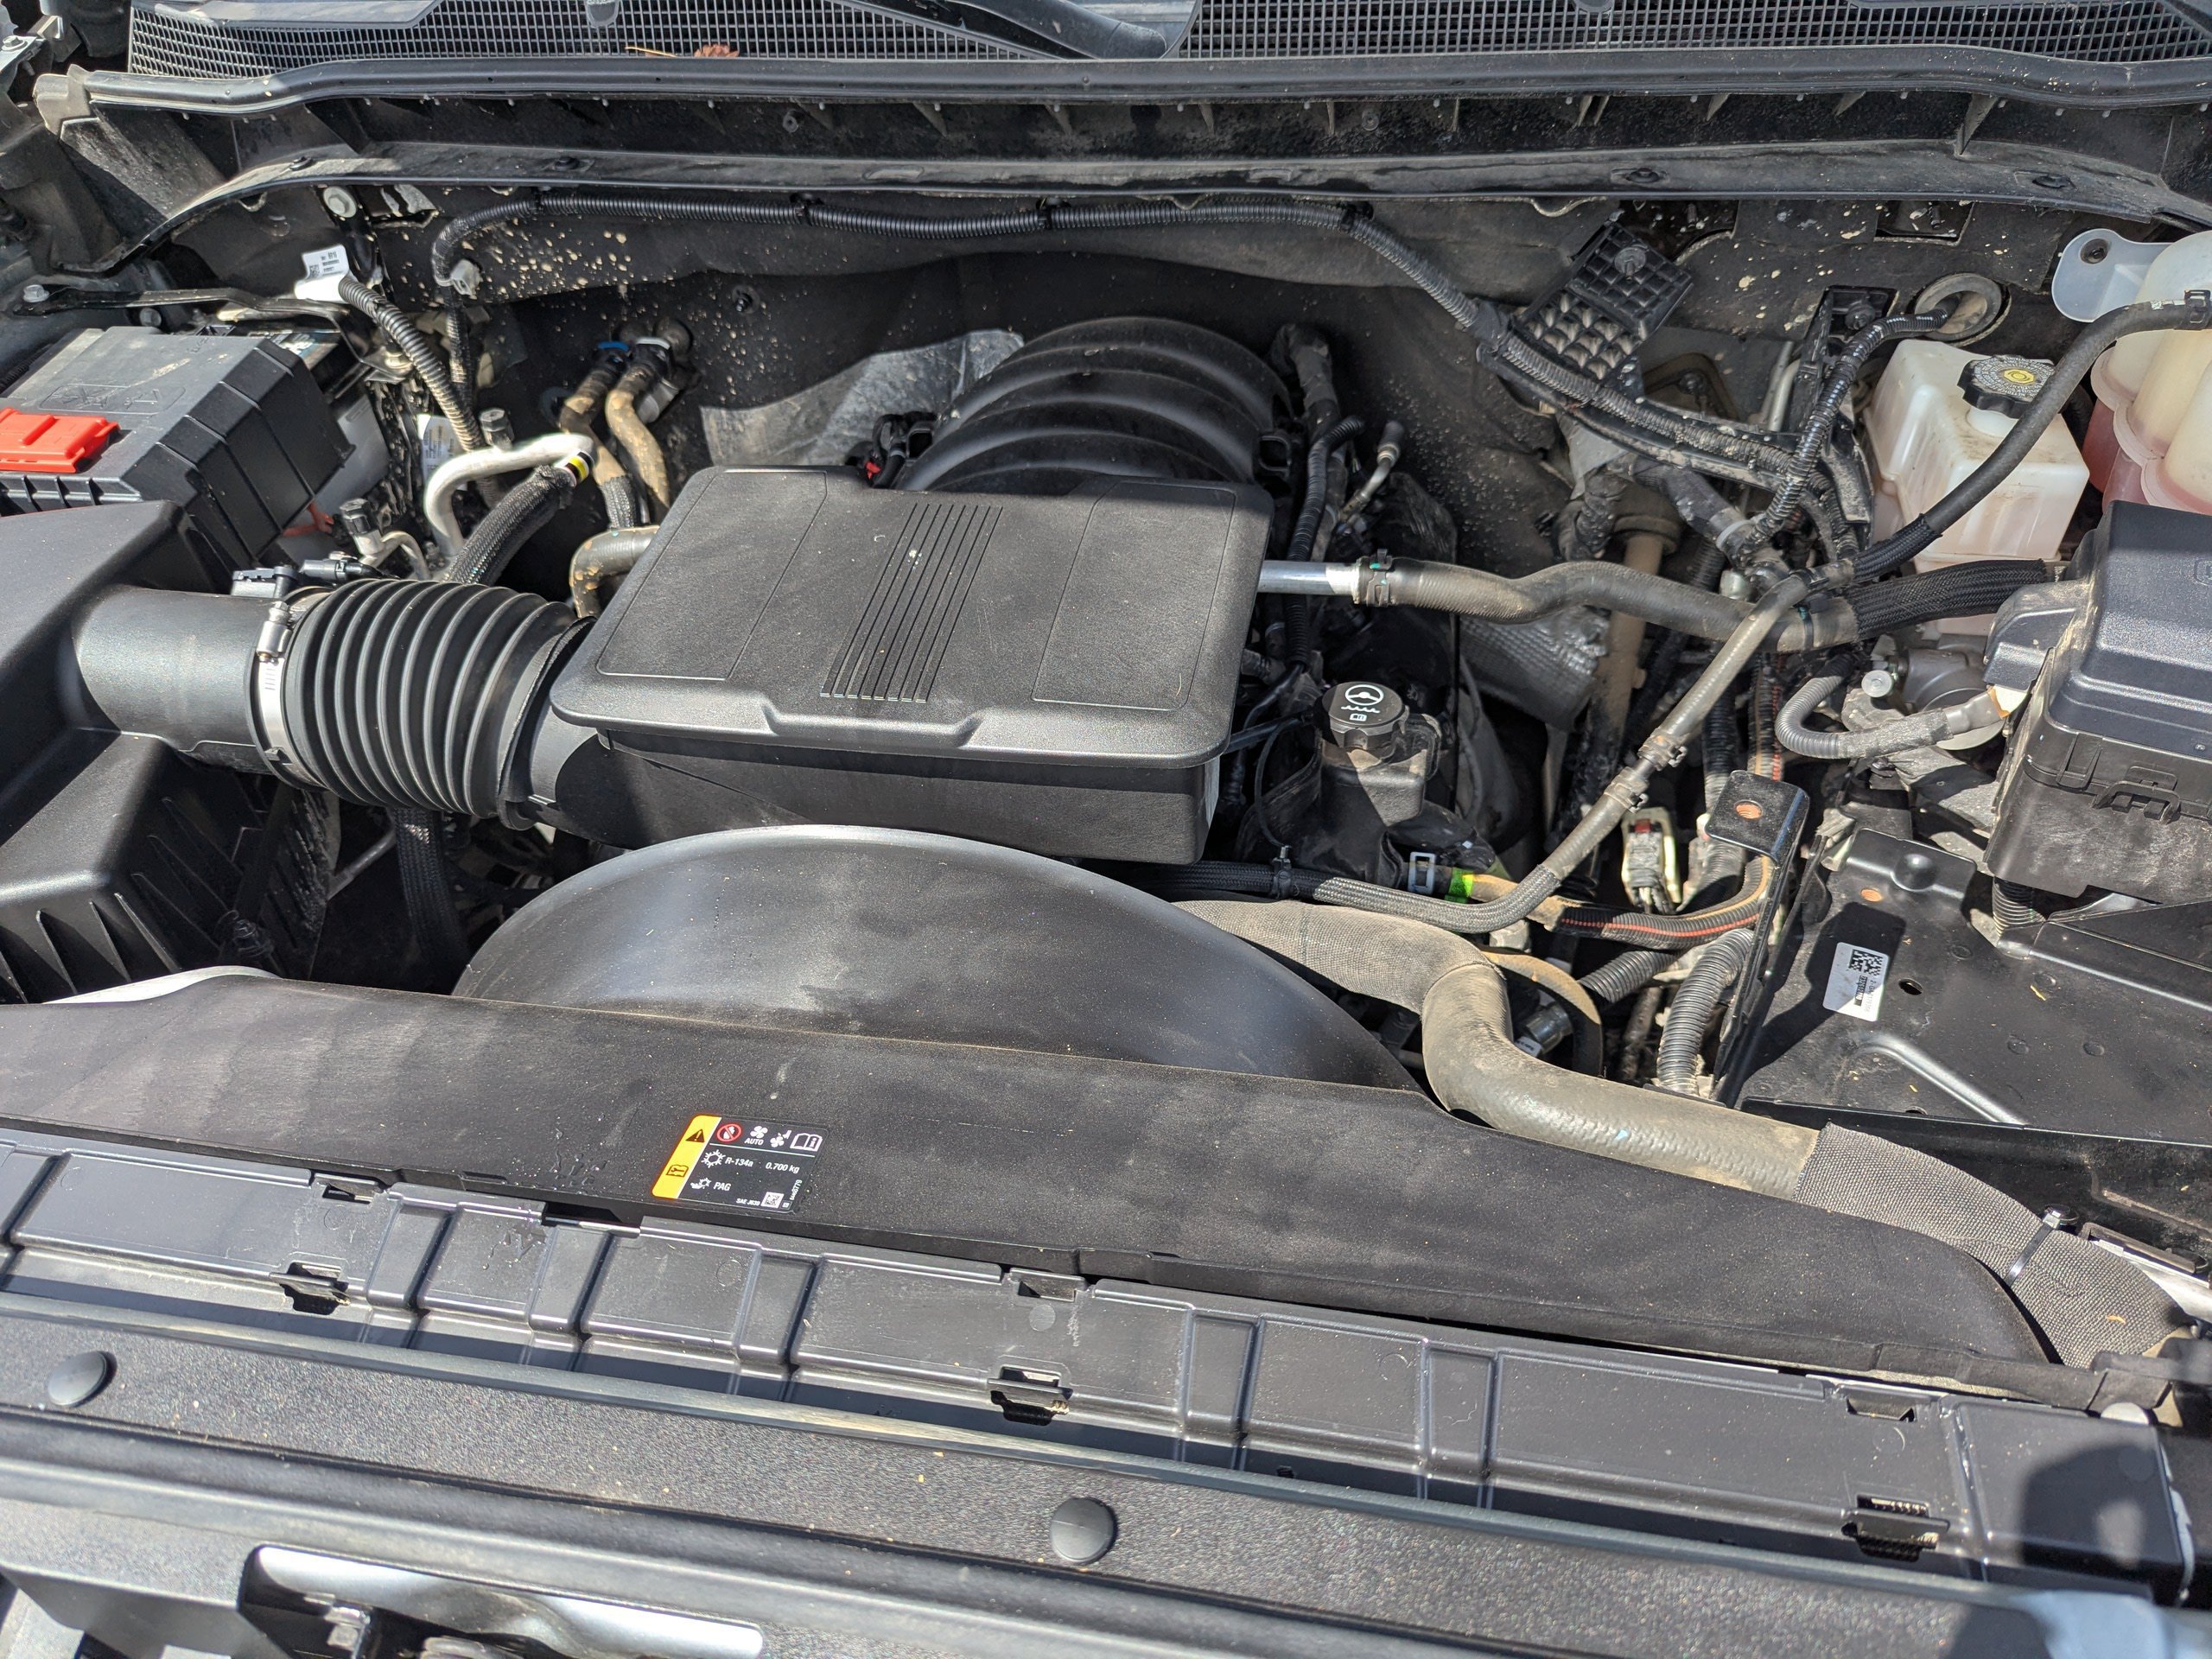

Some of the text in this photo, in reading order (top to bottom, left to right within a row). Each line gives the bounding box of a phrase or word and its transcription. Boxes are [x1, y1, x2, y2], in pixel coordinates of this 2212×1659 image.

[725, 1157, 754, 1167] R-134a
[766, 1161, 800, 1174] 0.700 kg
[713, 1181, 732, 1191] PAG
